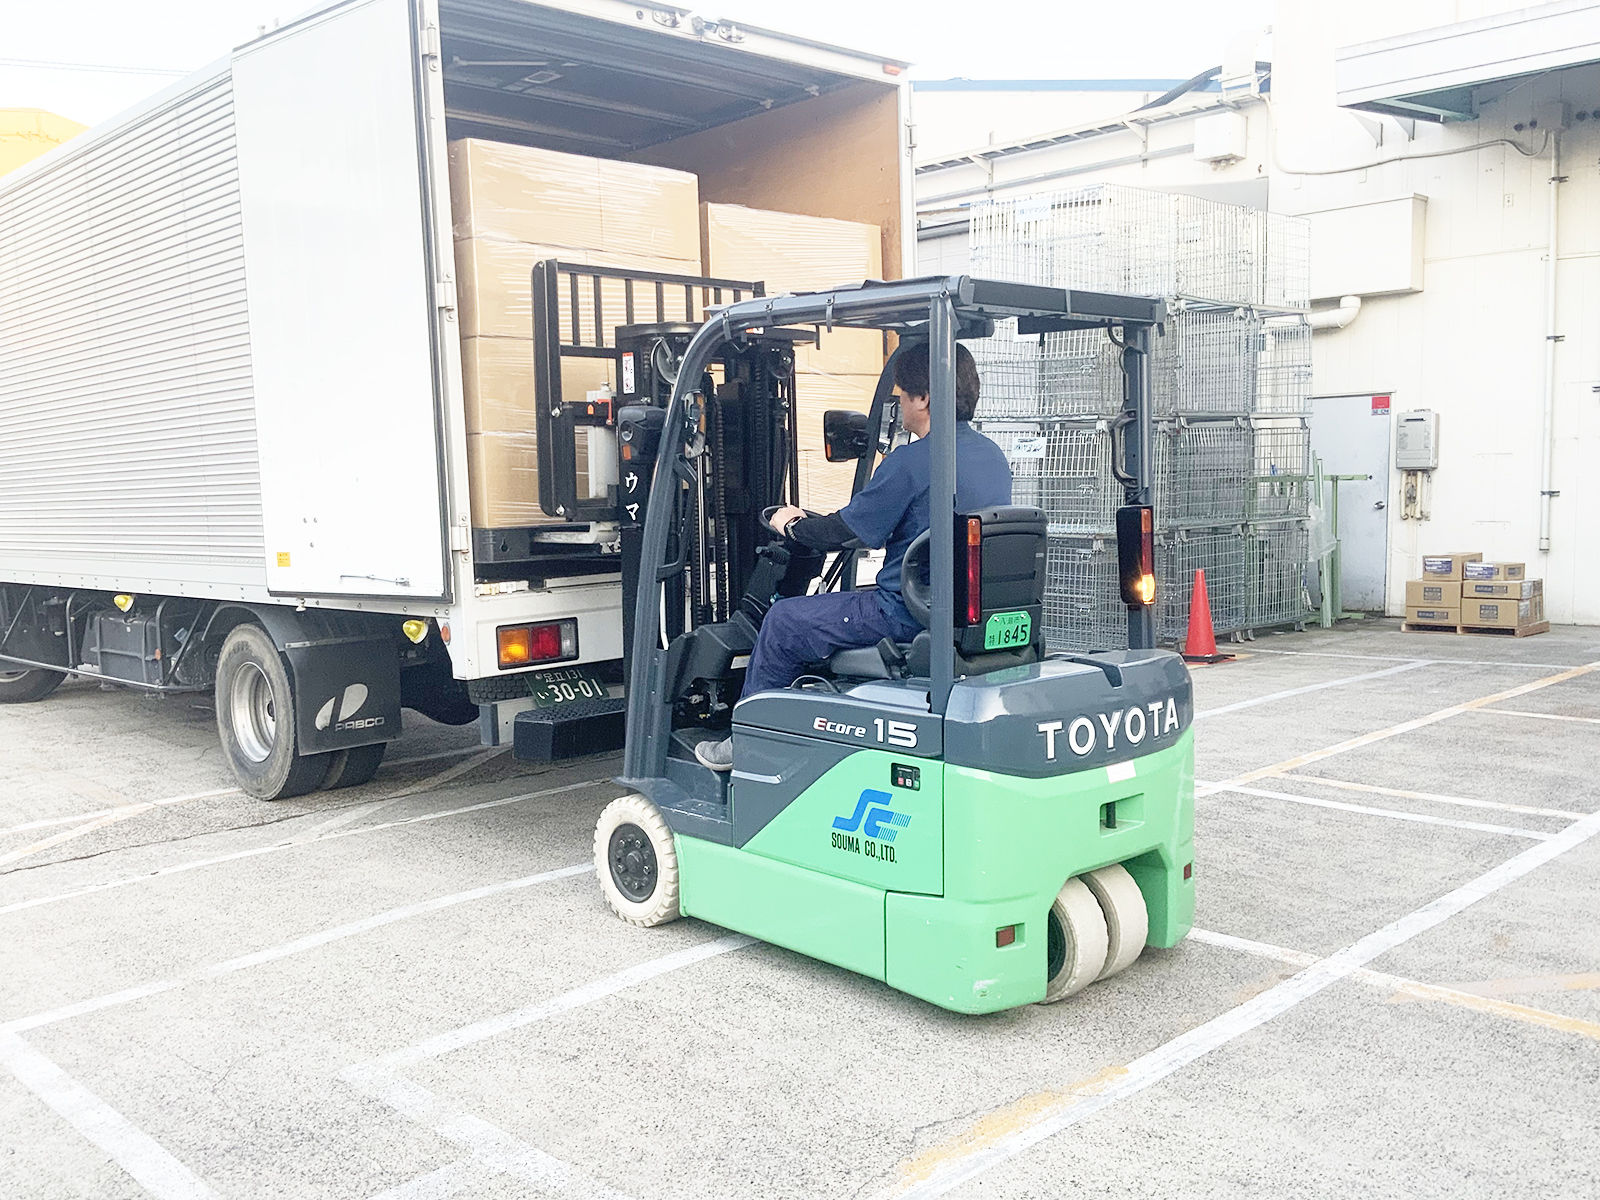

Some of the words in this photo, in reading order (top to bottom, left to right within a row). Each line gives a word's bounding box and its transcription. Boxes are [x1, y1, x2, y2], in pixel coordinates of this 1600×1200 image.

[998, 624, 1028, 644] 1845
[547, 678, 603, 703] 30-01
[335, 717, 385, 732] PABCO
[813, 716, 867, 738] Ecore
[873, 717, 918, 748] 15
[1037, 697, 1180, 761] TOYOTA
[831, 832, 861, 855] SOUMA
[864, 840, 898, 864] CO.,LTD.
